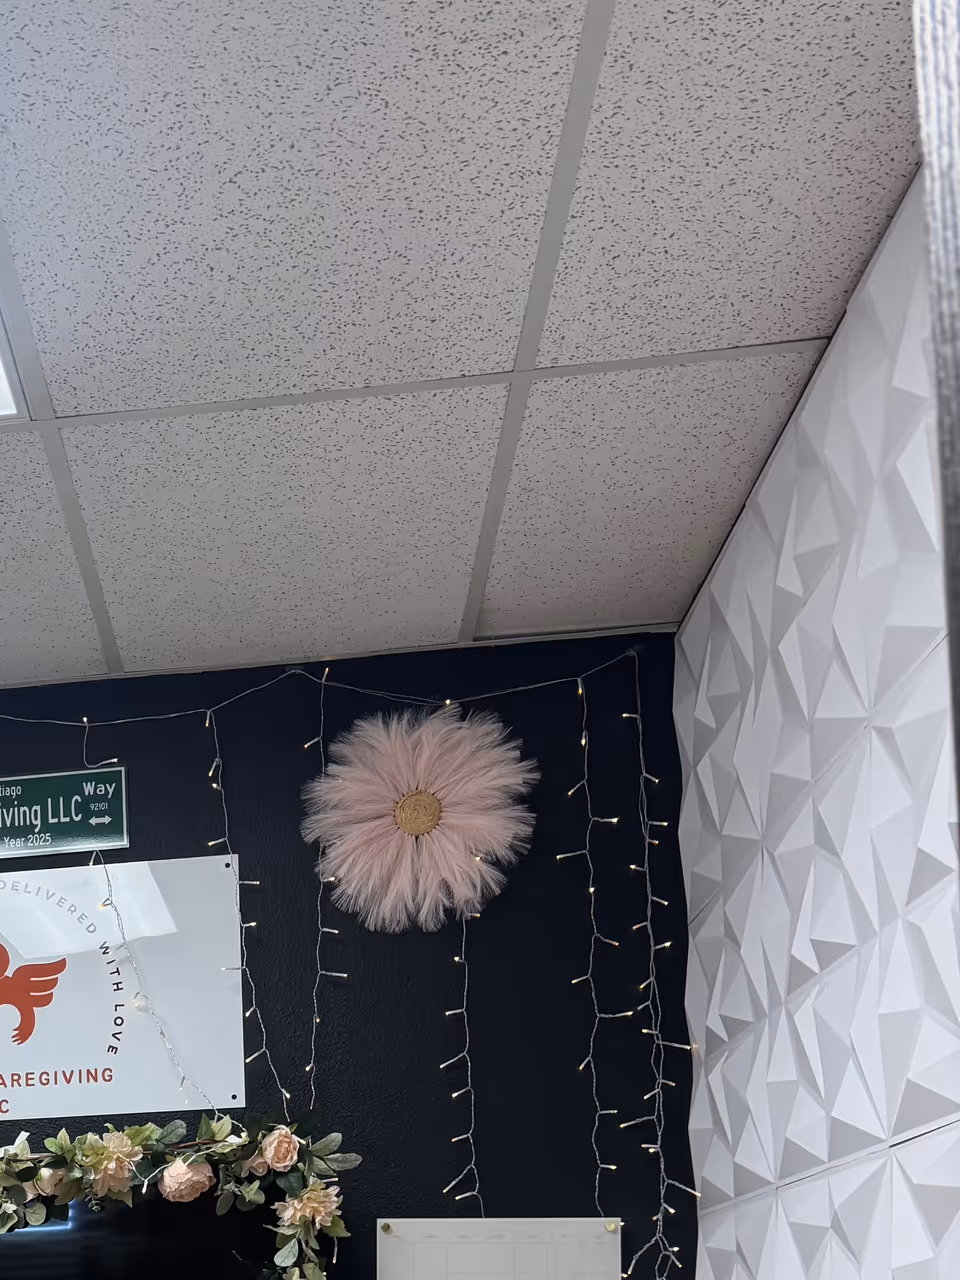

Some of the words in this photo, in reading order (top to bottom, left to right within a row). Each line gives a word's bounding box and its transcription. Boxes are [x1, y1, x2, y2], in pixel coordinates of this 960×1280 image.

[82, 781, 116, 799] Way
[47, 794, 82, 824] LLC
[89, 802, 108, 811] 92101
[3, 836, 25, 848] Year
[27, 833, 52, 846] 2025
[99, 941, 124, 992] WITH
[106, 1003, 125, 1055] LOVE
